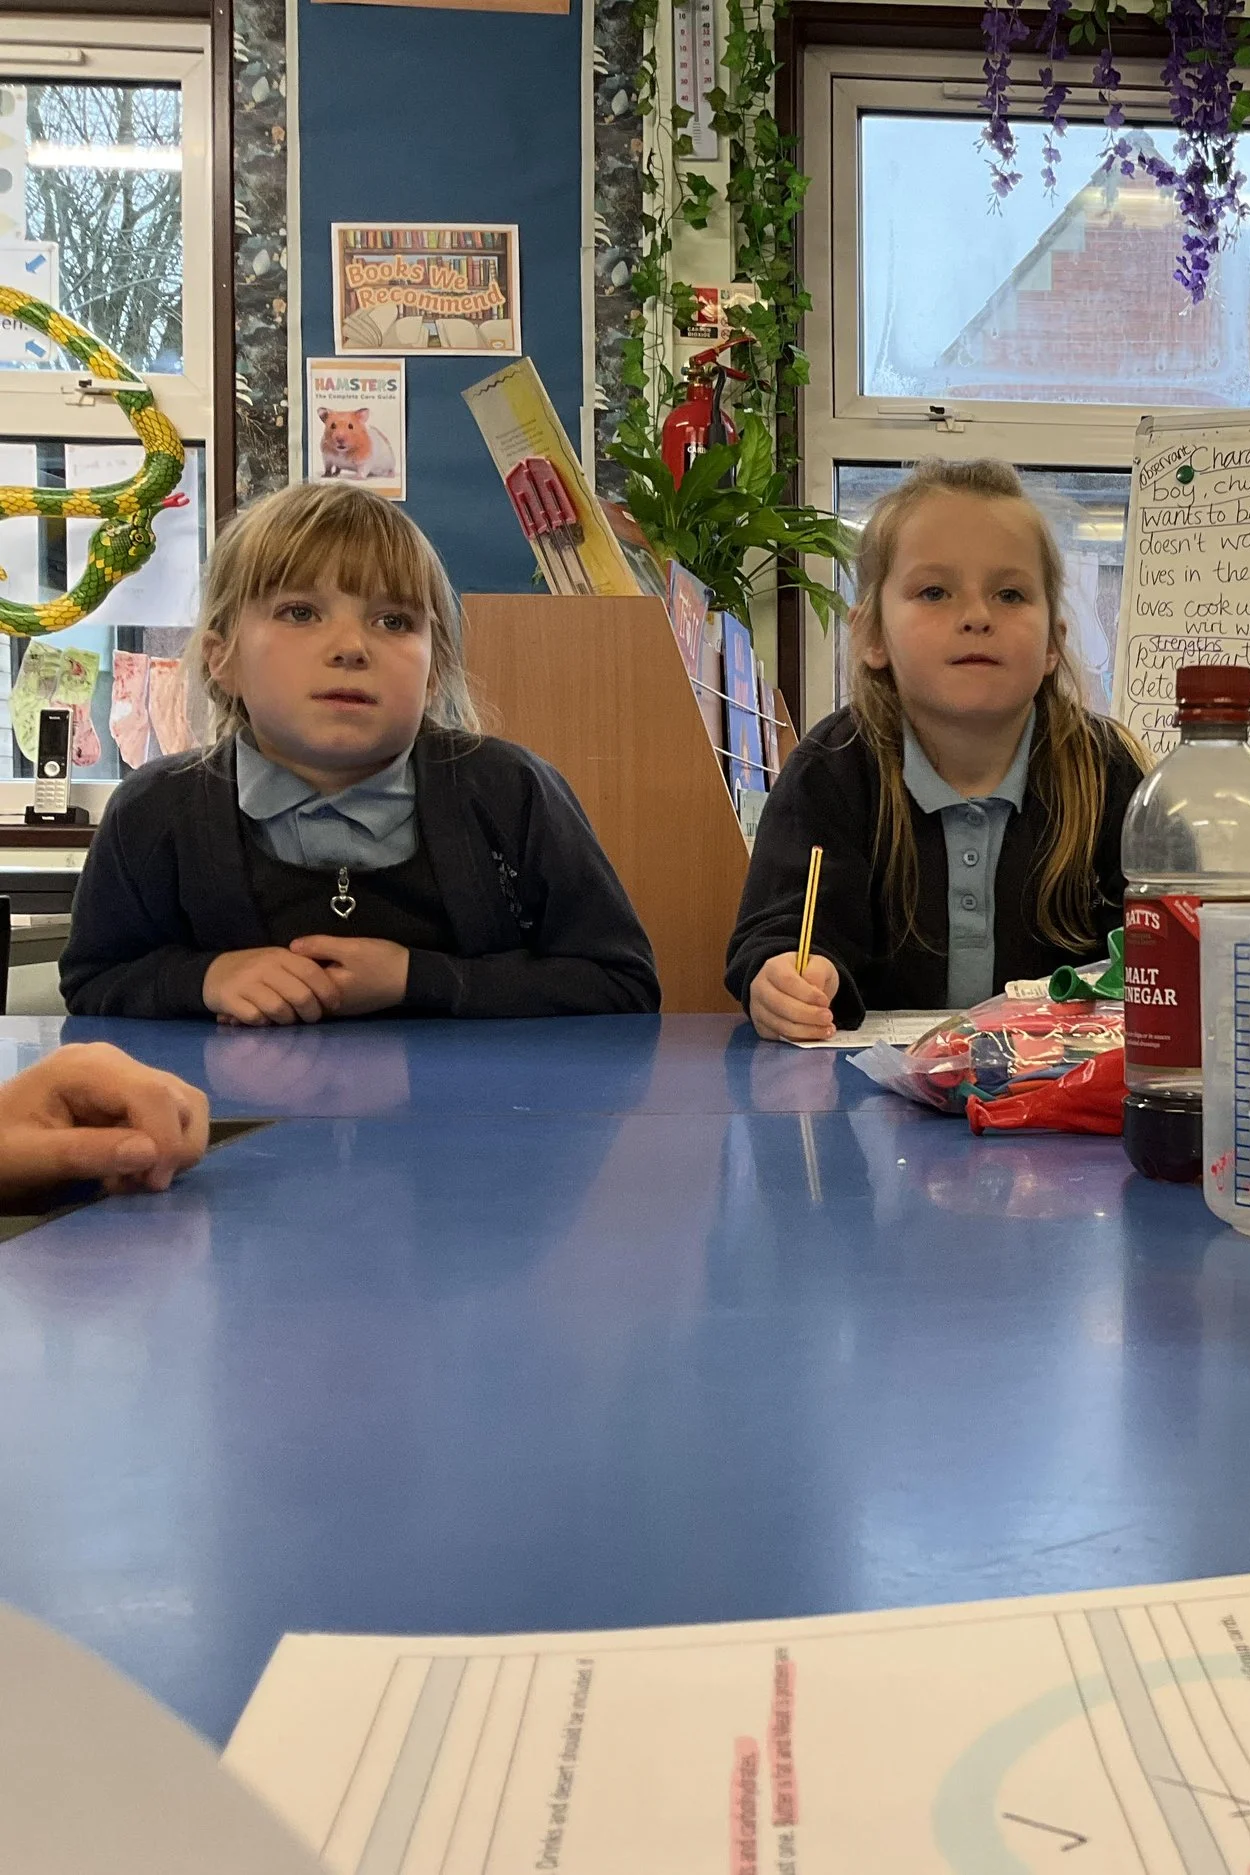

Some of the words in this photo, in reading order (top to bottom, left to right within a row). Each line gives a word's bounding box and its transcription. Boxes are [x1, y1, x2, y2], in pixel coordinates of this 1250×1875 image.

[346, 255, 424, 287] Books
[429, 265, 468, 291] We
[356, 281, 505, 314] Recommend
[2, 319, 28, 331] en.
[315, 378, 397, 392] HAMSTERS
[1144, 504, 1202, 527] wants
[1207, 503, 1226, 524] to
[1139, 532, 1206, 556] doesn't
[1139, 559, 1175, 587] lives
[1184, 565, 1202, 583] in
[1212, 560, 1250, 583] the
[1136, 593, 1175, 617] loves
[1184, 592, 1233, 618] cook
[1131, 671, 1176, 700] dete
[1125, 966, 1159, 986] MALT
[1124, 988, 1177, 1006] INEGAR
